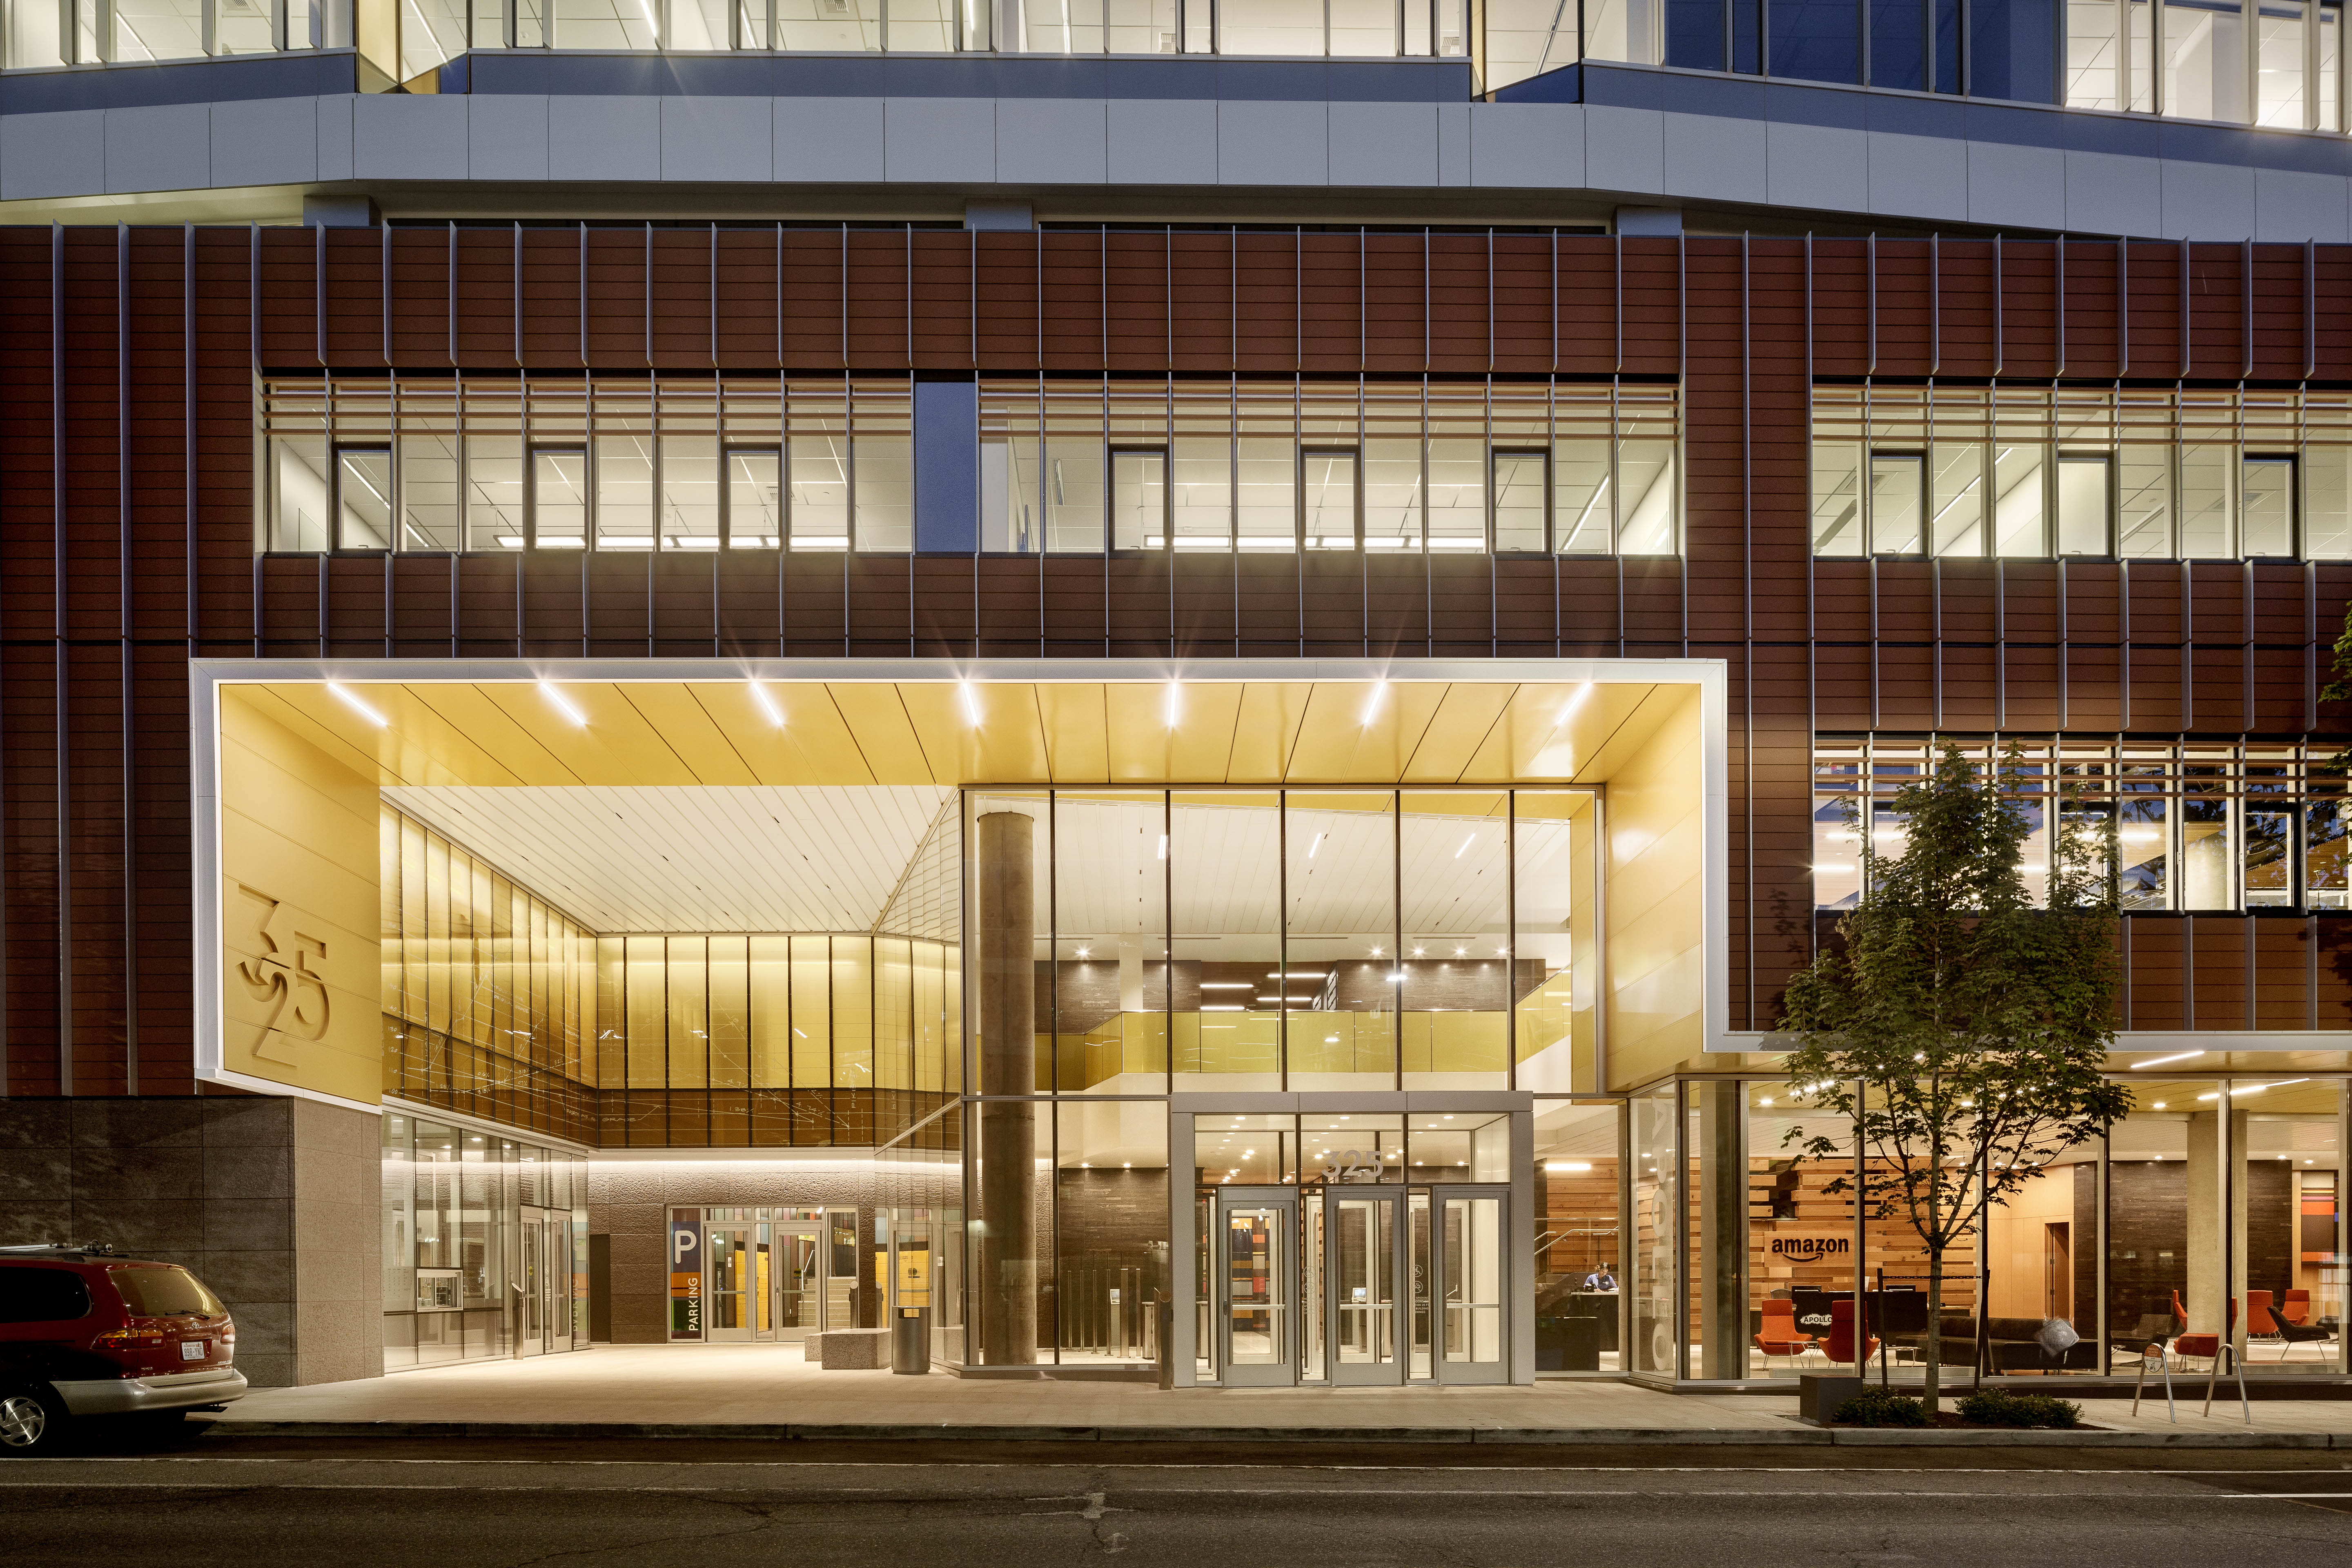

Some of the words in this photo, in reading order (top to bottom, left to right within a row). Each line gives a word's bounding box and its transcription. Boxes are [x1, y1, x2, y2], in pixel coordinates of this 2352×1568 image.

[235, 884, 330, 1069] 325
[1321, 1149, 1383, 1177] 325
[675, 1230, 697, 1263] P
[1772, 1238, 1849, 1253] amazon
[688, 1278, 698, 1331] PARKING
